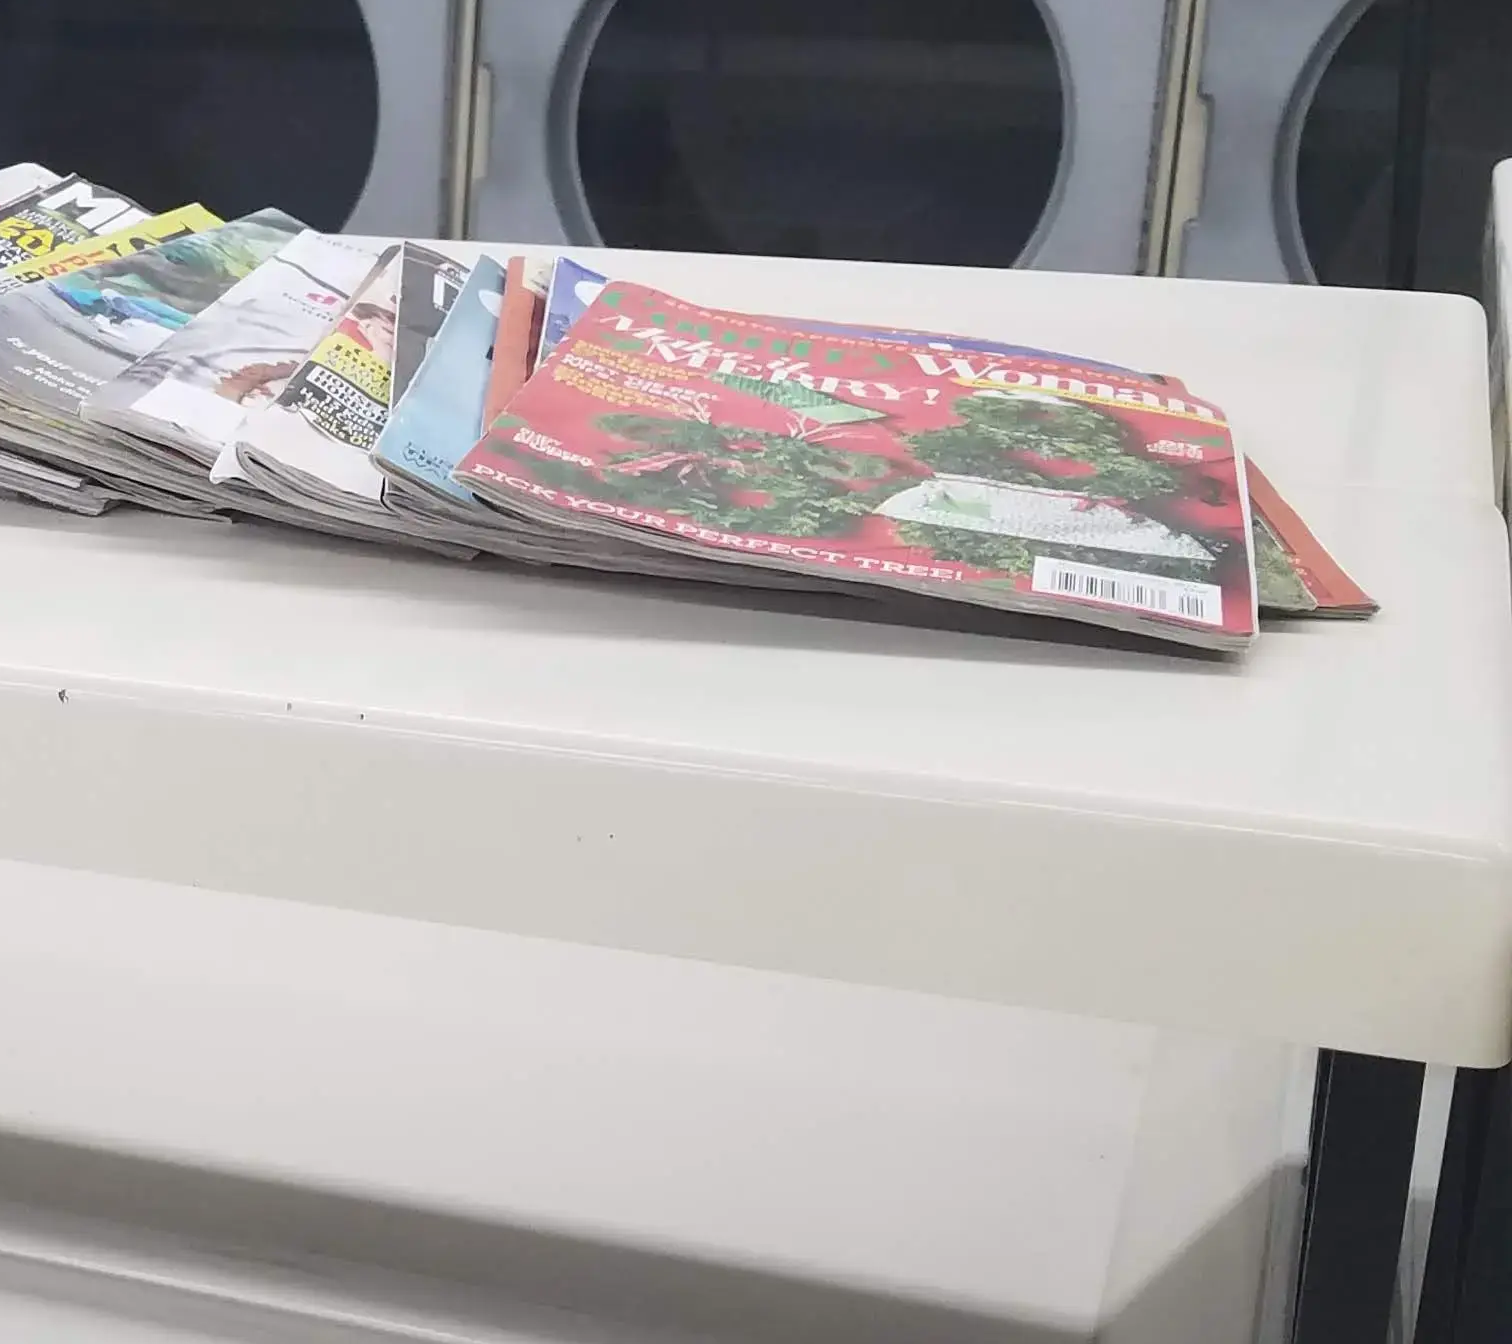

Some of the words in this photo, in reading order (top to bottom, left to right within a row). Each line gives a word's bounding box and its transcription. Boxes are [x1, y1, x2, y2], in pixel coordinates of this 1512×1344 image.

[910, 353, 1218, 421] Woman
[472, 463, 558, 501] PICK
[564, 496, 666, 529] YOUR
[675, 524, 847, 565] PERFECT
[853, 556, 963, 583] TREE!
